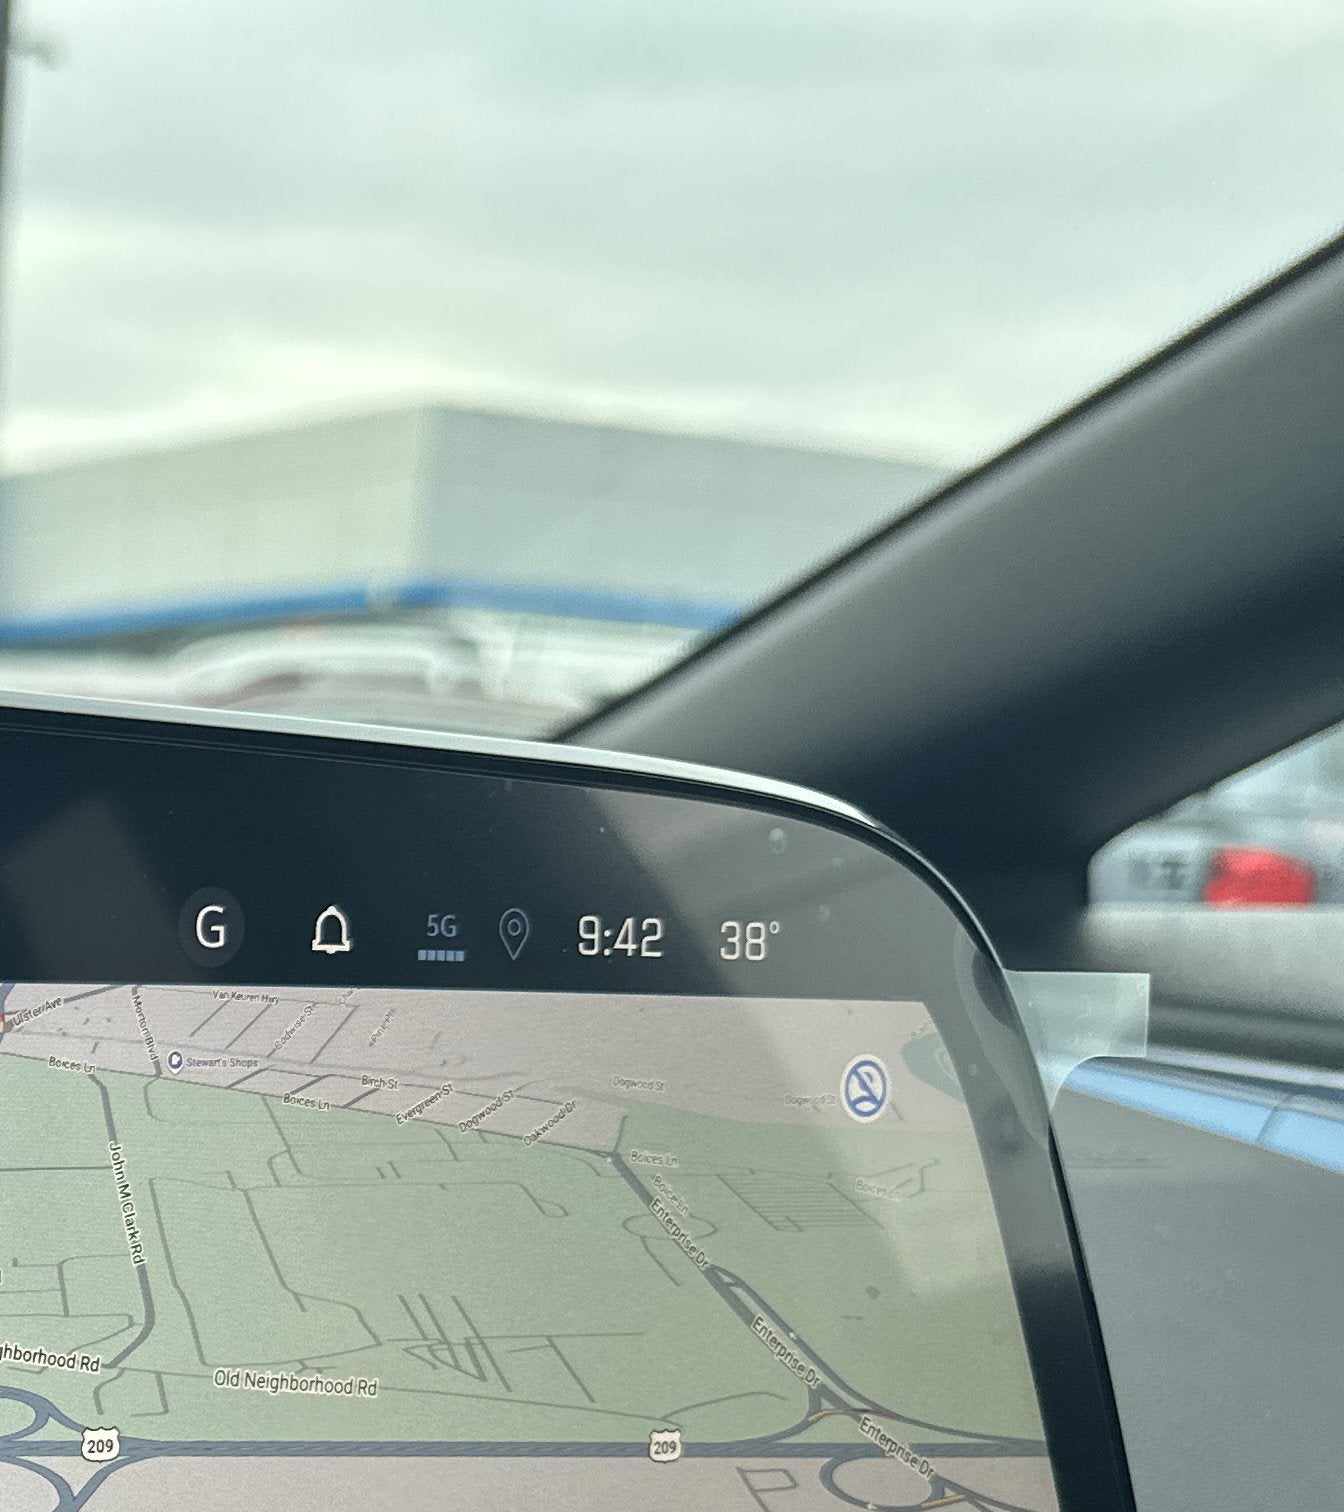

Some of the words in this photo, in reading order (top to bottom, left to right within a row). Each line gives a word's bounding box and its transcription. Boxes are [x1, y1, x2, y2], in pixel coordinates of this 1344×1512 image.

[196, 906, 227, 950] G
[426, 913, 458, 939] 5G
[577, 916, 664, 958] 9:42
[720, 920, 781, 961] 38°
[12, 1005, 45, 1027] Ulster
[45, 996, 63, 1012] Ave
[131, 995, 149, 1032] Morton
[143, 1035, 159, 1061] Blvd
[83, 1063, 97, 1073] Ln
[229, 1058, 259, 1069] Shops
[362, 1074, 385, 1088] Birch
[387, 1079, 399, 1090] St
[318, 1099, 330, 1111] Ln
[395, 1092, 440, 1125] Evergreen
[440, 1082, 454, 1096] St
[458, 1098, 503, 1133] Dogwood
[502, 1088, 515, 1102] St
[523, 1109, 566, 1147] Oakwood
[564, 1099, 577, 1114] Dr
[109, 1141, 126, 1181] John
[117, 1182, 132, 1200] M
[122, 1201, 140, 1241] Clark
[651, 1198, 697, 1256] Enterprise
[695, 1250, 709, 1268] Dr
[130, 1243, 146, 1265] Rd
[80, 1355, 101, 1373] Rd
[752, 1315, 806, 1377] Enterprise
[804, 1367, 821, 1387] Dr
[214, 1369, 240, 1388] Old
[244, 1373, 354, 1396] Neighborhood
[357, 1378, 378, 1396] Rd
[86, 1438, 114, 1454] 209
[653, 1439, 678, 1456] 209
[859, 1416, 920, 1469] Enterprise
[919, 1459, 935, 1478] Dr
